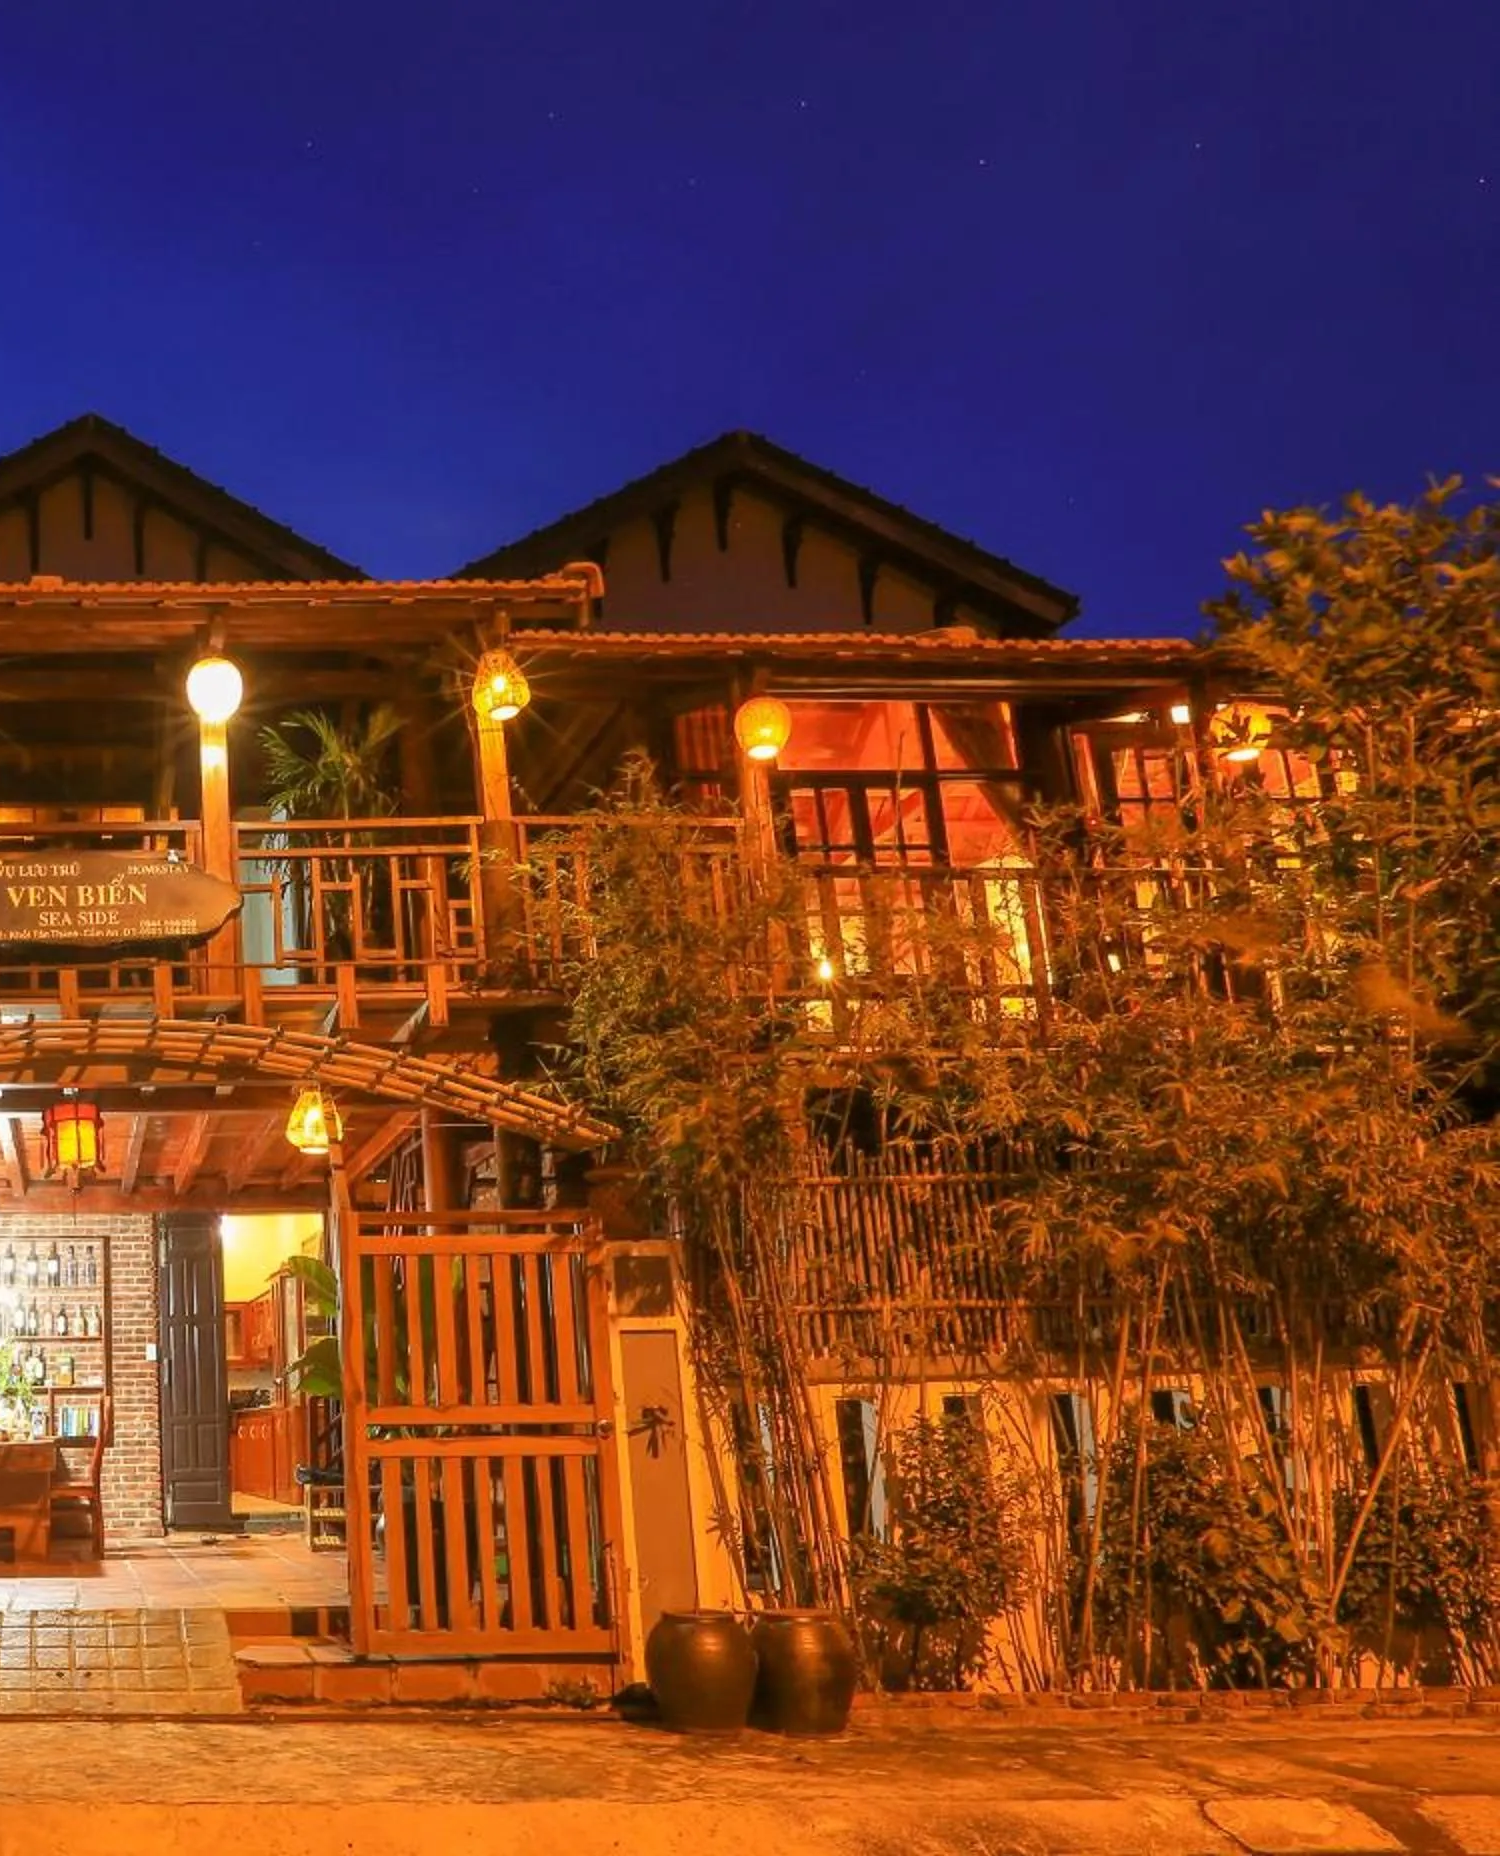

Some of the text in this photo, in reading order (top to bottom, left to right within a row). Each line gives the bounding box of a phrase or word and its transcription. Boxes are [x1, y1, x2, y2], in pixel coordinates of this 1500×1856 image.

[127, 863, 190, 875] HOMESTAY
[6, 873, 147, 907] VEN BIỂN
[38, 910, 120, 927] SEA SIDE
